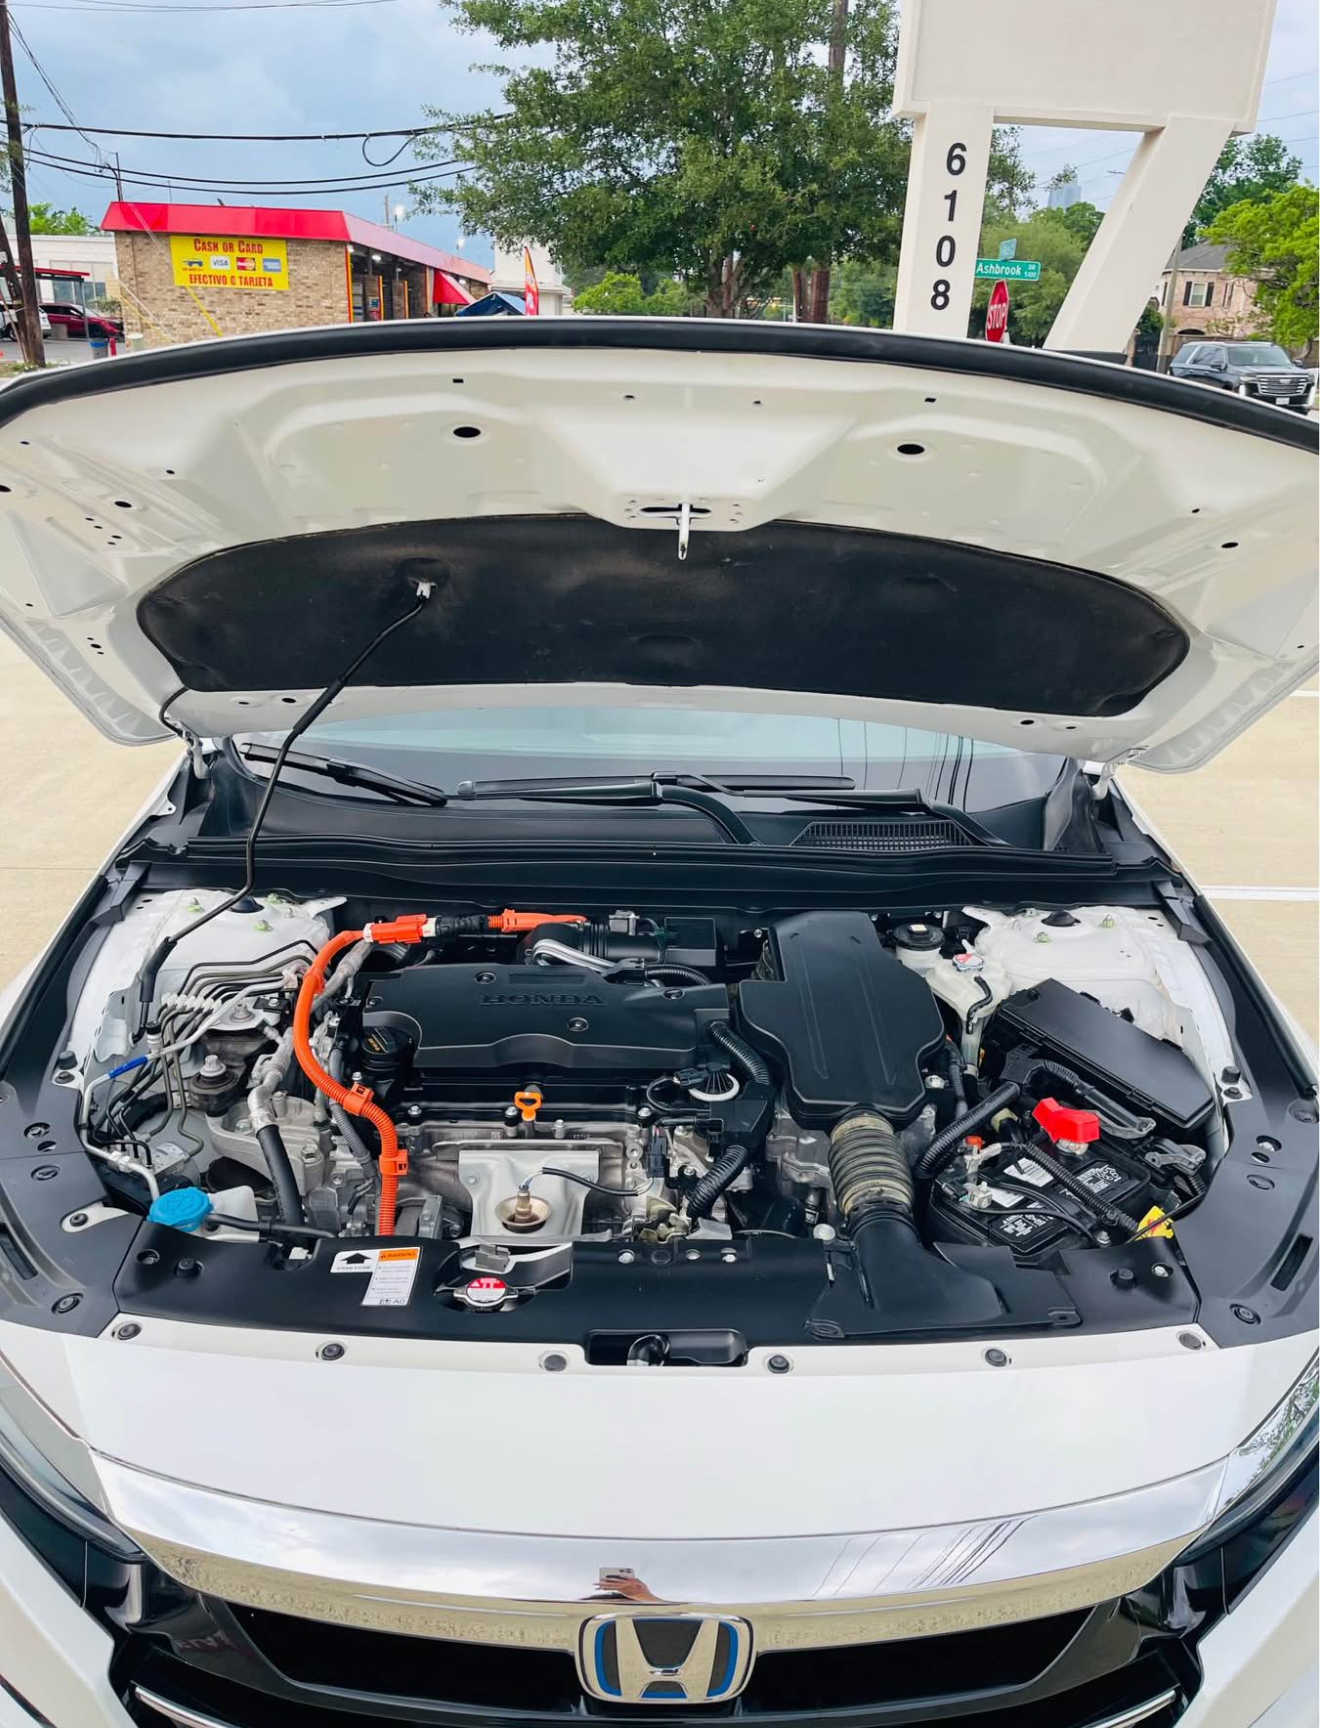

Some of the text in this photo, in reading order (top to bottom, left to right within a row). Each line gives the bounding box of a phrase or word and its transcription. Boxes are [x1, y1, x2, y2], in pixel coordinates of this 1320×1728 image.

[931, 142, 967, 310] 6108
[212, 257, 229, 266] VISA
[976, 262, 1021, 276] Ashbrook
[189, 273, 274, 287] EFECTIVO O TARJETA
[987, 302, 1007, 330] STOP
[479, 993, 608, 1006] HONDA
